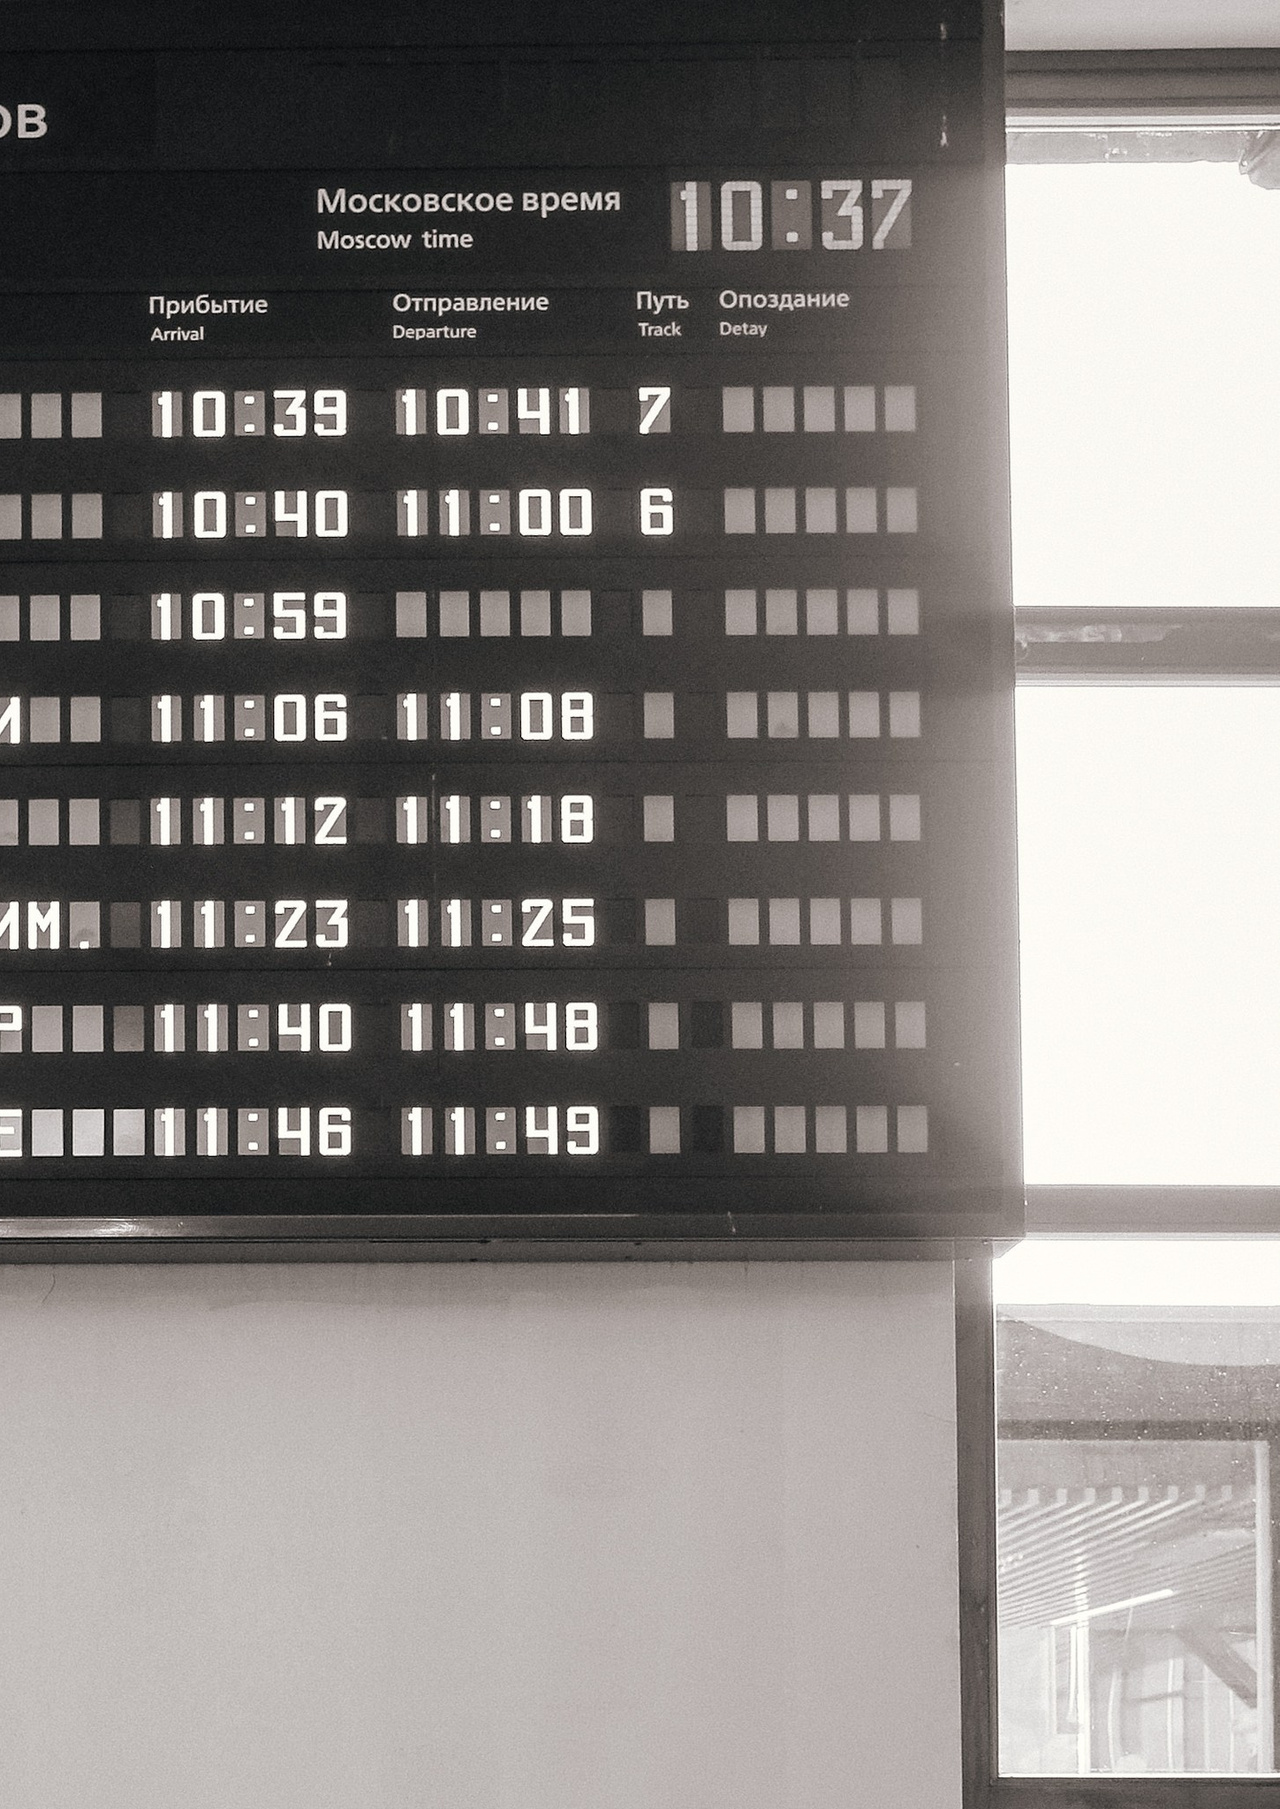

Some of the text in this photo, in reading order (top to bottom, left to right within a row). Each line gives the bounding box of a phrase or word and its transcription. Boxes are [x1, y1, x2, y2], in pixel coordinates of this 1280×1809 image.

[317, 188, 621, 219] Московское время
[682, 179, 913, 252] 10:37
[317, 228, 474, 250] Moscow time
[149, 293, 269, 318] Прибытие
[392, 293, 550, 317] Отправление
[636, 290, 690, 315] Путь
[719, 289, 851, 312] Опоздание
[150, 325, 205, 342] Arrival
[392, 324, 478, 341] Departure
[637, 321, 682, 337] Track
[719, 321, 768, 338] Detay
[158, 390, 347, 438] 10:39
[402, 388, 580, 435] 10:41
[638, 387, 671, 434] 7
[158, 490, 348, 539] 10:40
[403, 489, 592, 537] 11:00
[640, 488, 673, 535] 6
[157, 592, 346, 640] 10:59
[157, 694, 347, 743] 11:06
[403, 692, 593, 741] 11:08
[156, 797, 347, 846] 11:12
[403, 795, 593, 844] 11:18
[157, 900, 348, 948] 11:23
[404, 898, 595, 947] 11:25
[160, 1003, 352, 1052] 11:40
[408, 1002, 598, 1051] 11:48
[160, 1107, 351, 1156] 11:46
[408, 1106, 599, 1156] 11:49
